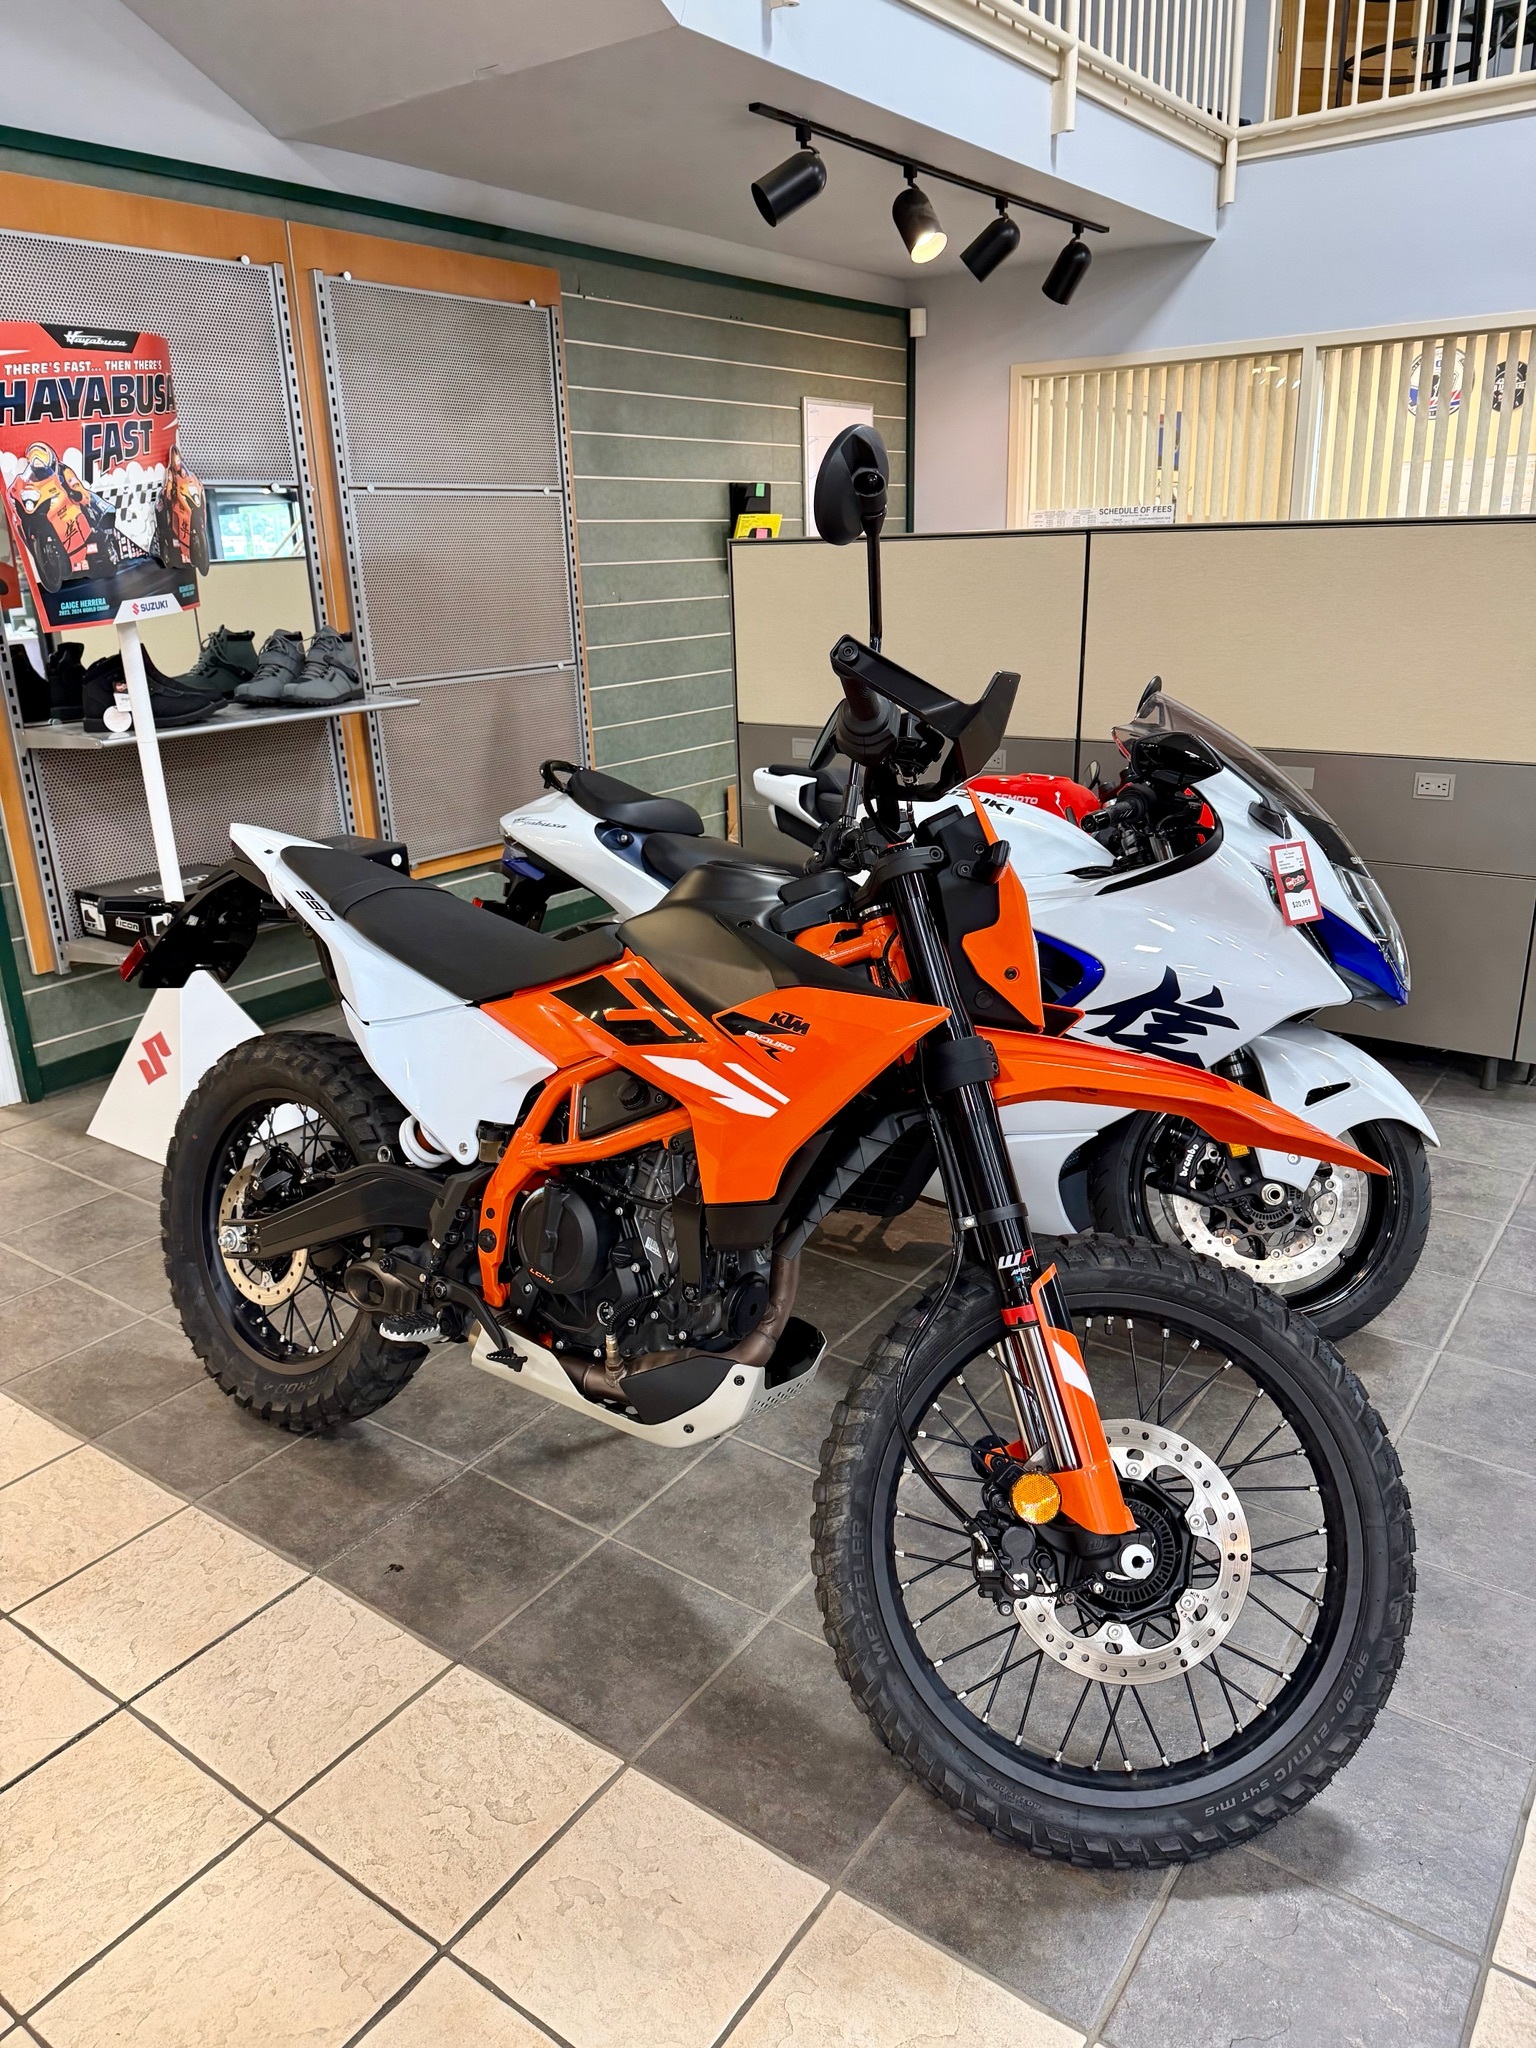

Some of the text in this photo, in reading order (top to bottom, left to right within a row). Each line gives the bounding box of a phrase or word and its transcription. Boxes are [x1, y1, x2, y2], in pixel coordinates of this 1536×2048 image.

[4, 360, 162, 375] THERE'S FAST... THEN THERE'S
[0, 372, 176, 427] HAYABUSA
[82, 419, 154, 486] FAST
[1098, 506, 1139, 516] SCHEDULE
[1140, 505, 1151, 514] OF
[1152, 505, 1173, 513] FEES
[80, 597, 106, 608] HERRERA
[140, 600, 169, 613] SUZUKI
[768, 1010, 811, 1036] KTM
[744, 1029, 797, 1054] ENDURO
[1179, 1143, 1199, 1177] brembo
[852, 1519, 890, 1666] METZELER
[1336, 1650, 1370, 1714] 90/90
[1312, 1725, 1331, 1747] 21
[1274, 1745, 1313, 1782] M/C
